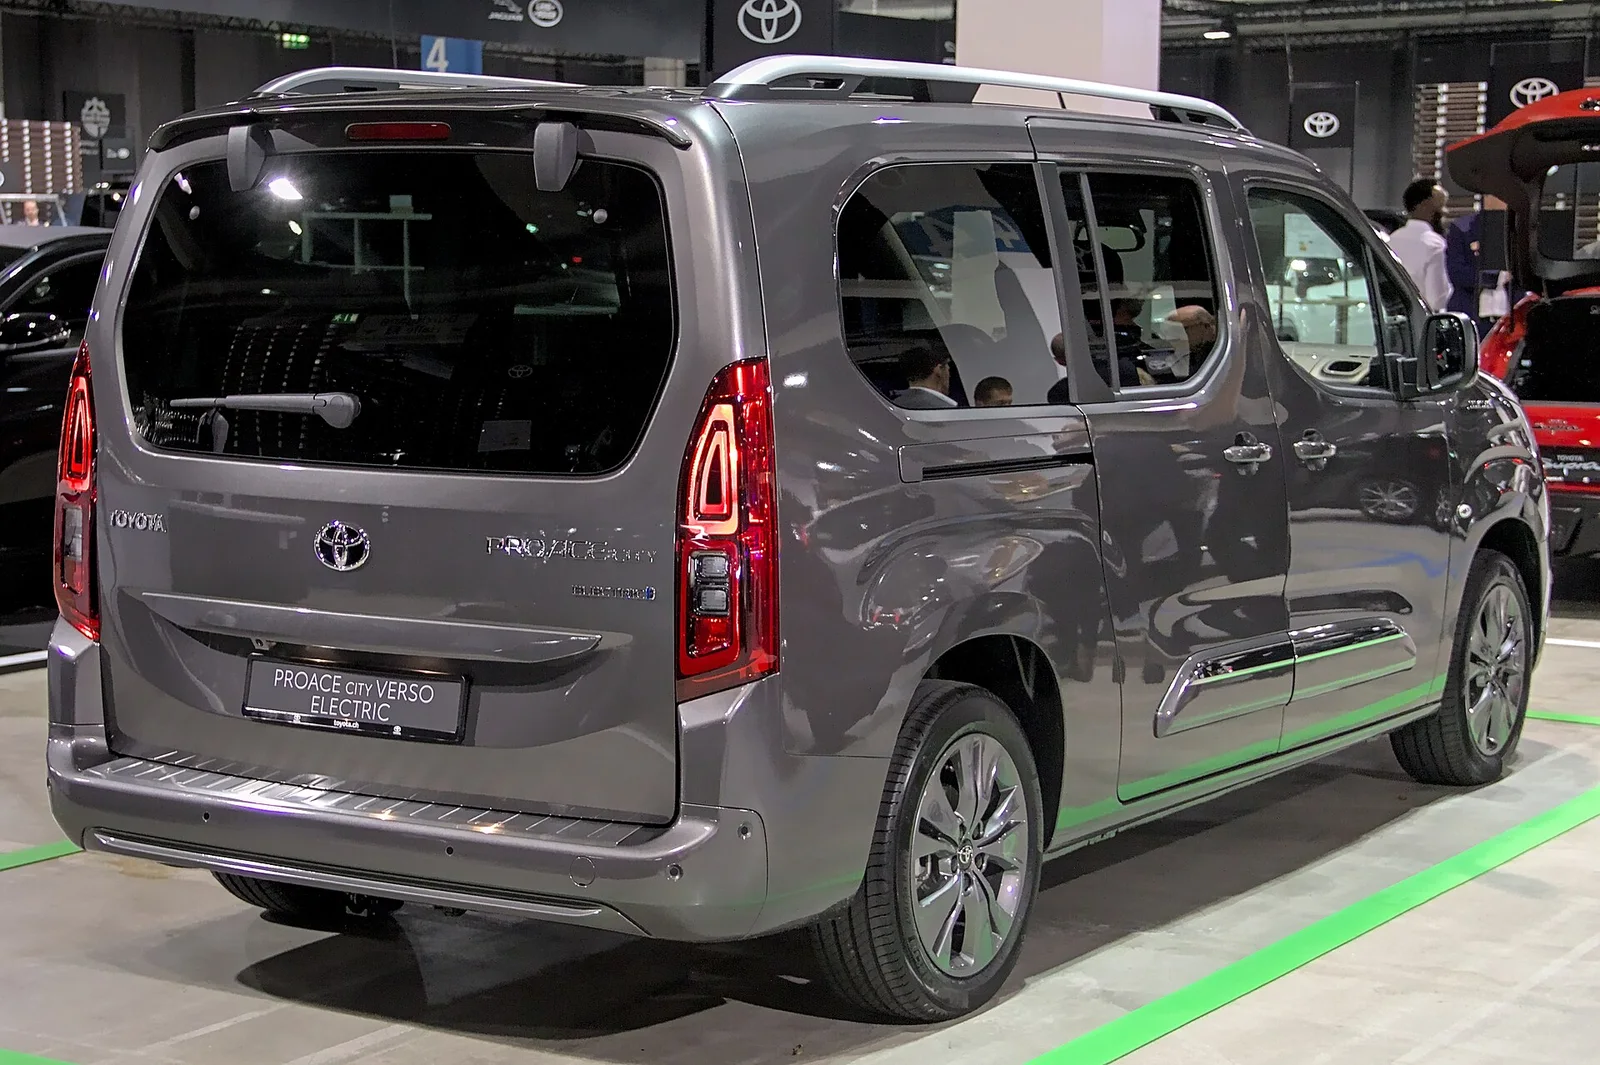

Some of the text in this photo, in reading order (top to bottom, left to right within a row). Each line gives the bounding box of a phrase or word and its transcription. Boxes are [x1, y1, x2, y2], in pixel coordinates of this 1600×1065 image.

[426, 36, 449, 72] 4
[110, 509, 164, 532] TOYOTA
[273, 668, 434, 704] PROACE CITY VERSO
[310, 695, 391, 722] ELECTRIC
[333, 718, 360, 729] toyota.ch
